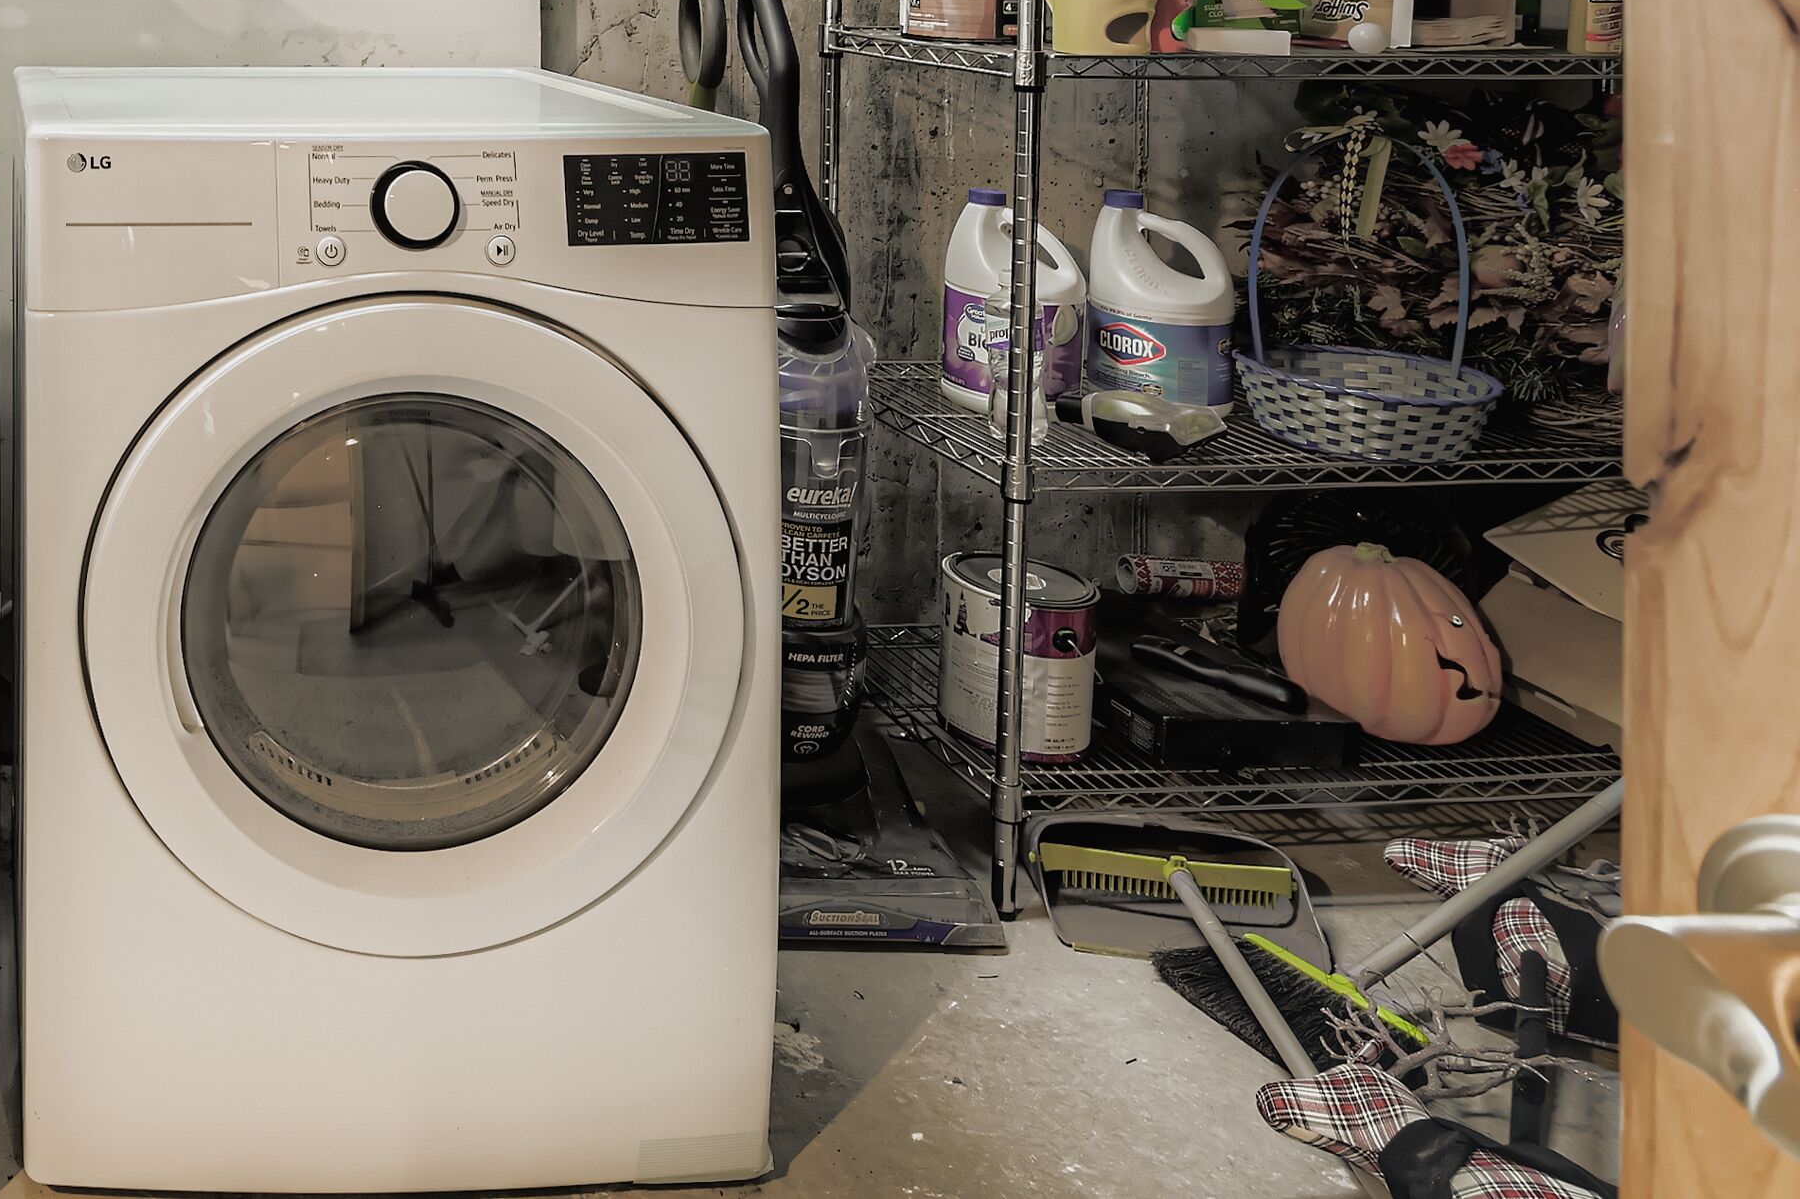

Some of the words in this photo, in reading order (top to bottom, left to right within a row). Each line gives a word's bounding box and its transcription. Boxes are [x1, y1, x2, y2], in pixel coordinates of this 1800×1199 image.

[90, 156, 111, 169] LG
[312, 176, 333, 185] Heavy
[334, 176, 350, 185] Duty
[313, 200, 341, 209] Bedding
[482, 199, 502, 207] Speed
[503, 199, 514, 208] Dry
[504, 223, 516, 232] Dry
[684, 227, 696, 236] Dry
[577, 229, 588, 239] Dry
[589, 229, 605, 237] Level
[1100, 329, 1154, 359] CLOROX
[781, 534, 848, 554] BETTER
[781, 548, 833, 567] THAN
[781, 563, 847, 581] DYSON
[788, 652, 815, 663] HEPA
[817, 653, 844, 663] FILTER
[798, 725, 825, 733] CORD
[790, 730, 830, 739] REWIND
[886, 859, 908, 871] 12
